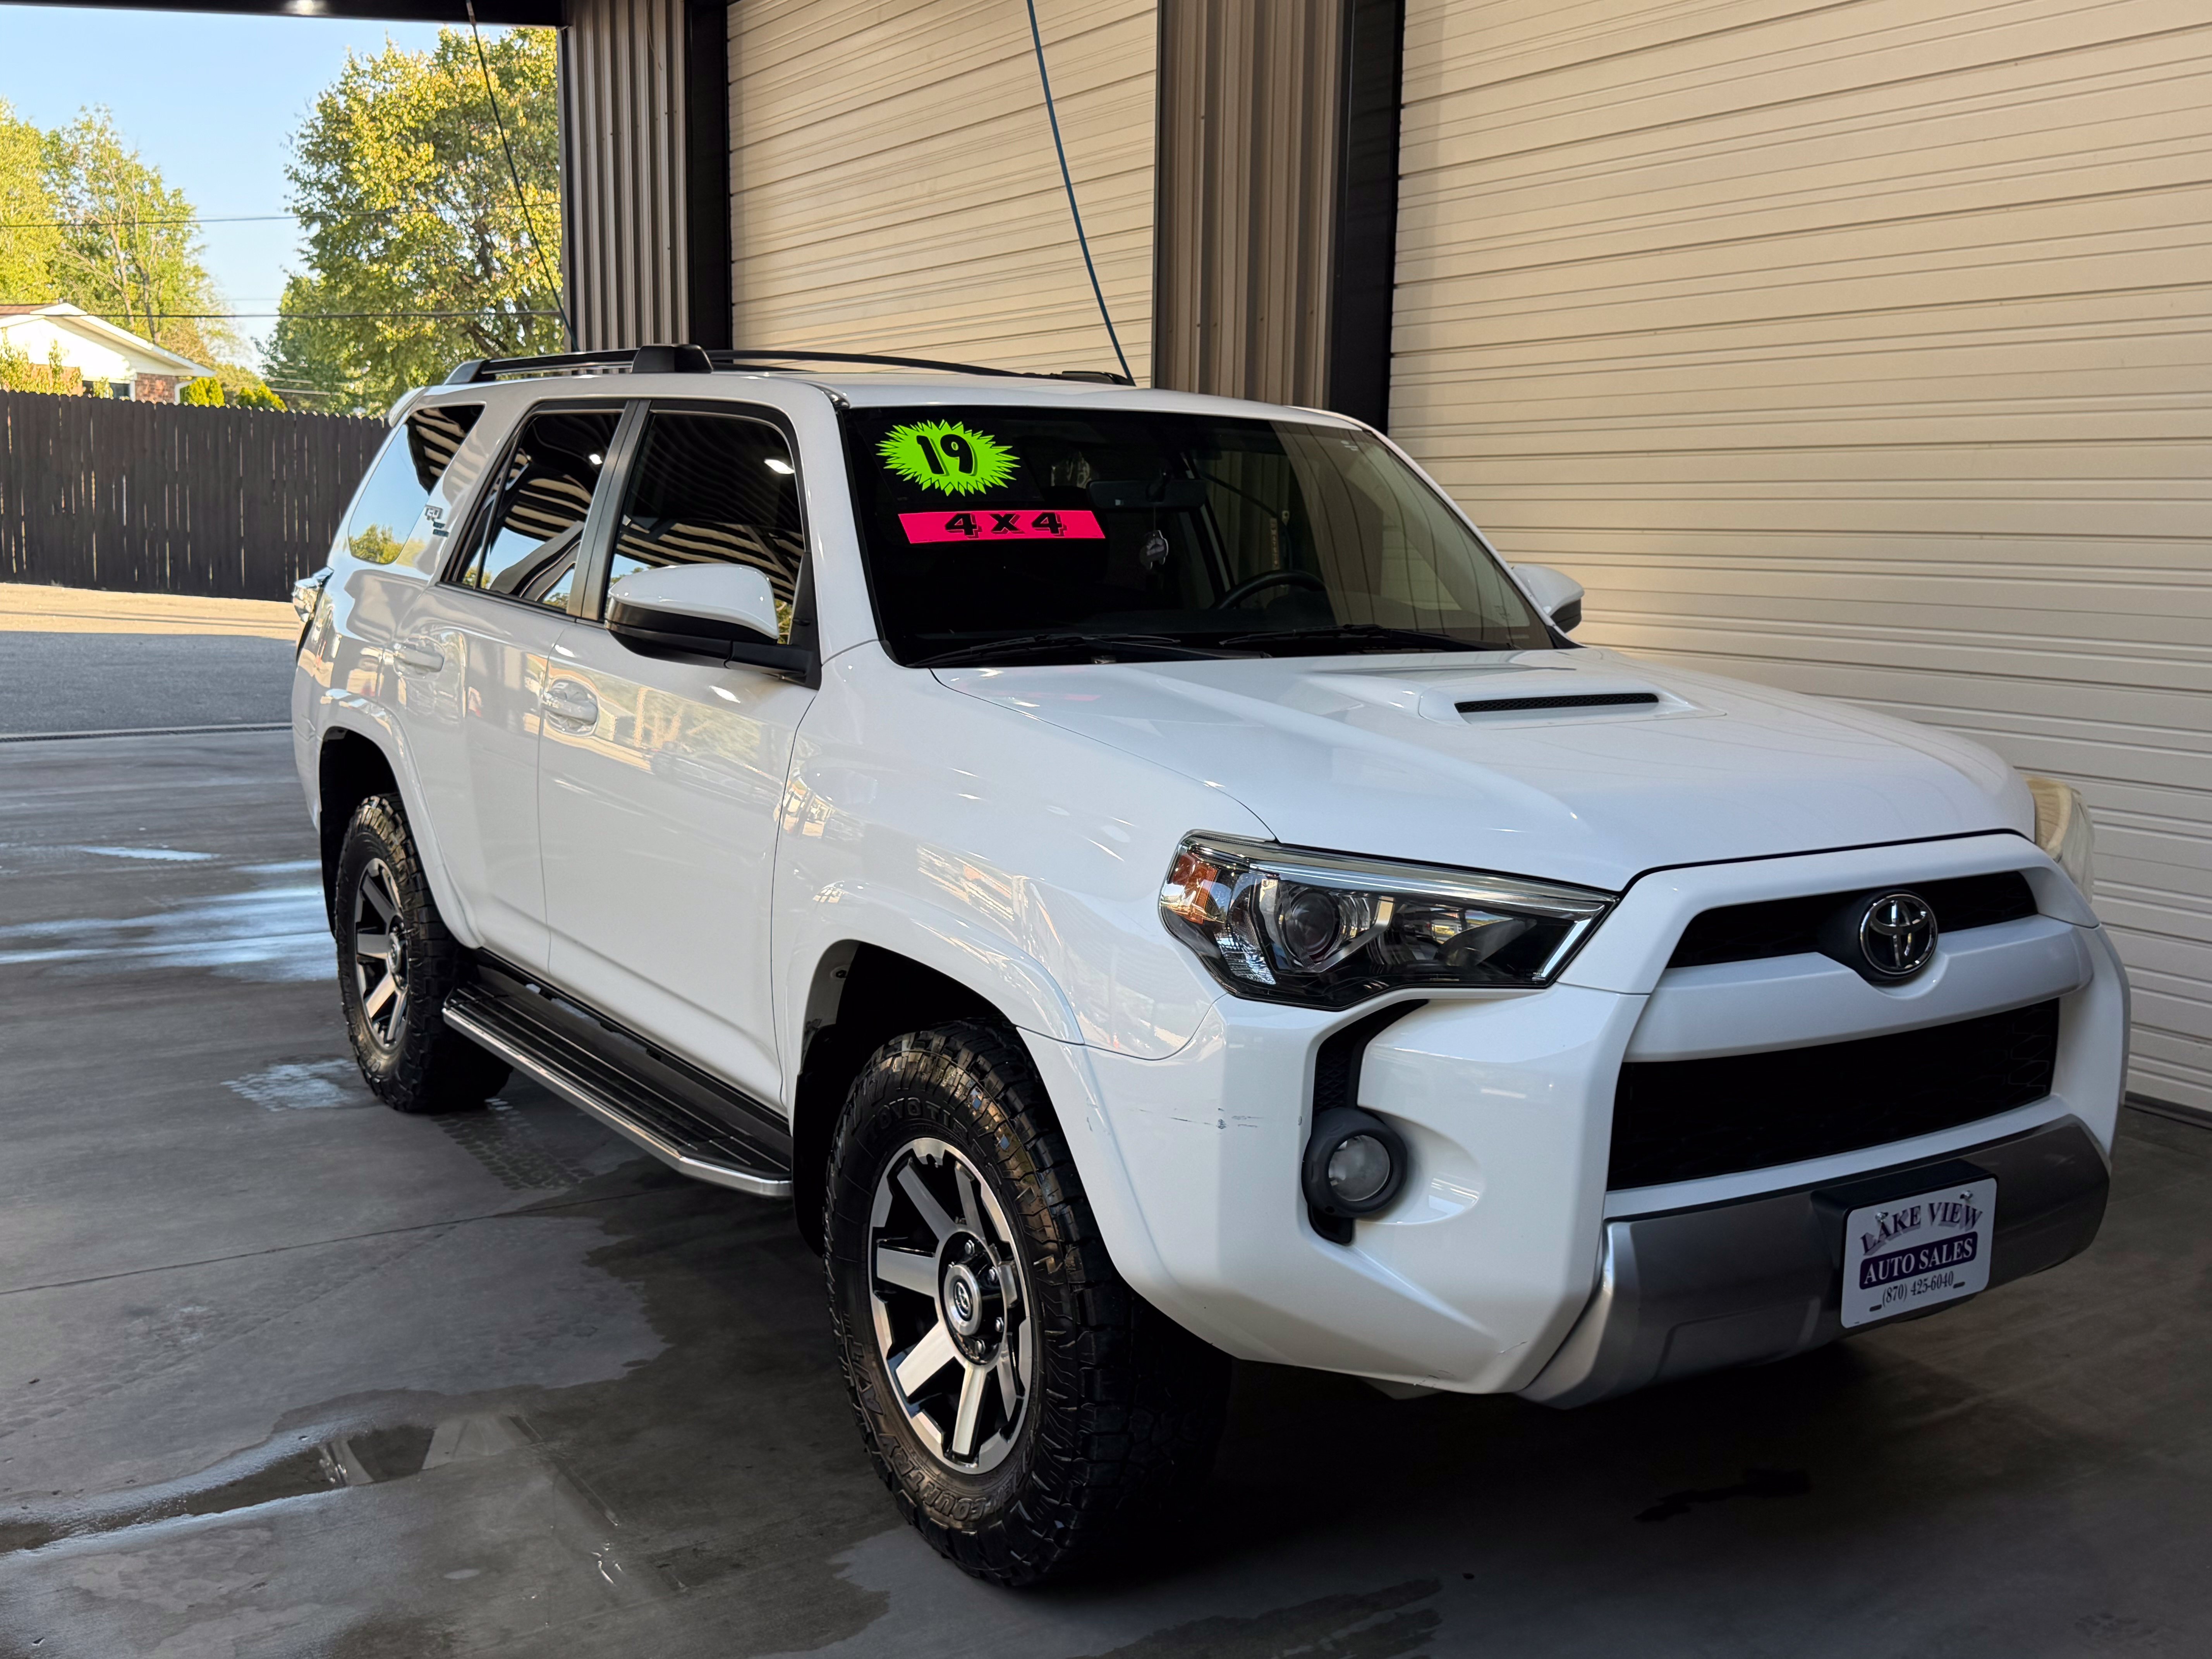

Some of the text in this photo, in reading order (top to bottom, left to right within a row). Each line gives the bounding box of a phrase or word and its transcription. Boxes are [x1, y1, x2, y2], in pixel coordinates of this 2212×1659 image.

[916, 434, 978, 477] 19
[1860, 1202, 1983, 1255] LAKE VIEW
[1863, 1238, 1973, 1285] AUTO SALES
[1882, 1271, 1954, 1307] (870) 425-6040
